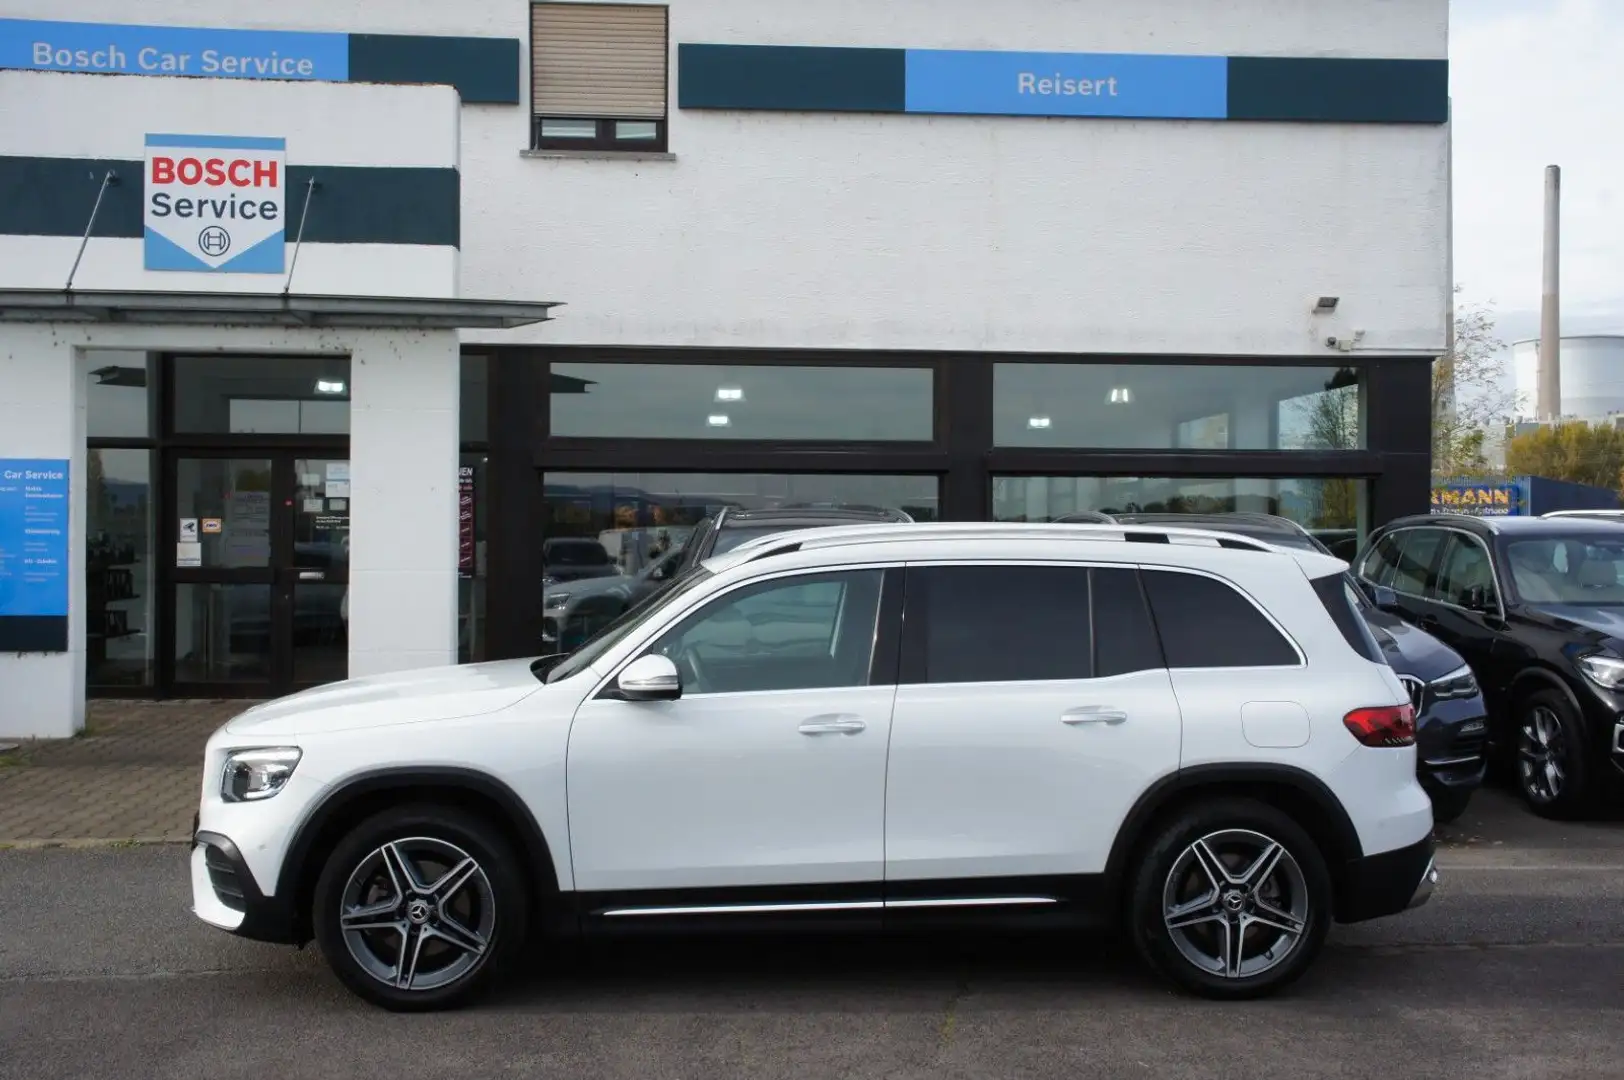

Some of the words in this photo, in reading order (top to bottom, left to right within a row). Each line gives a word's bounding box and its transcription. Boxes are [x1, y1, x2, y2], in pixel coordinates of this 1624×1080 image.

[32, 42, 126, 69] Bosch
[137, 48, 190, 71] Car
[201, 50, 314, 76] Service
[1017, 73, 1118, 96] Reisert
[151, 157, 278, 187] BOSCH
[150, 193, 279, 221] Service
[4, 470, 22, 480] Car
[25, 470, 64, 480] Service
